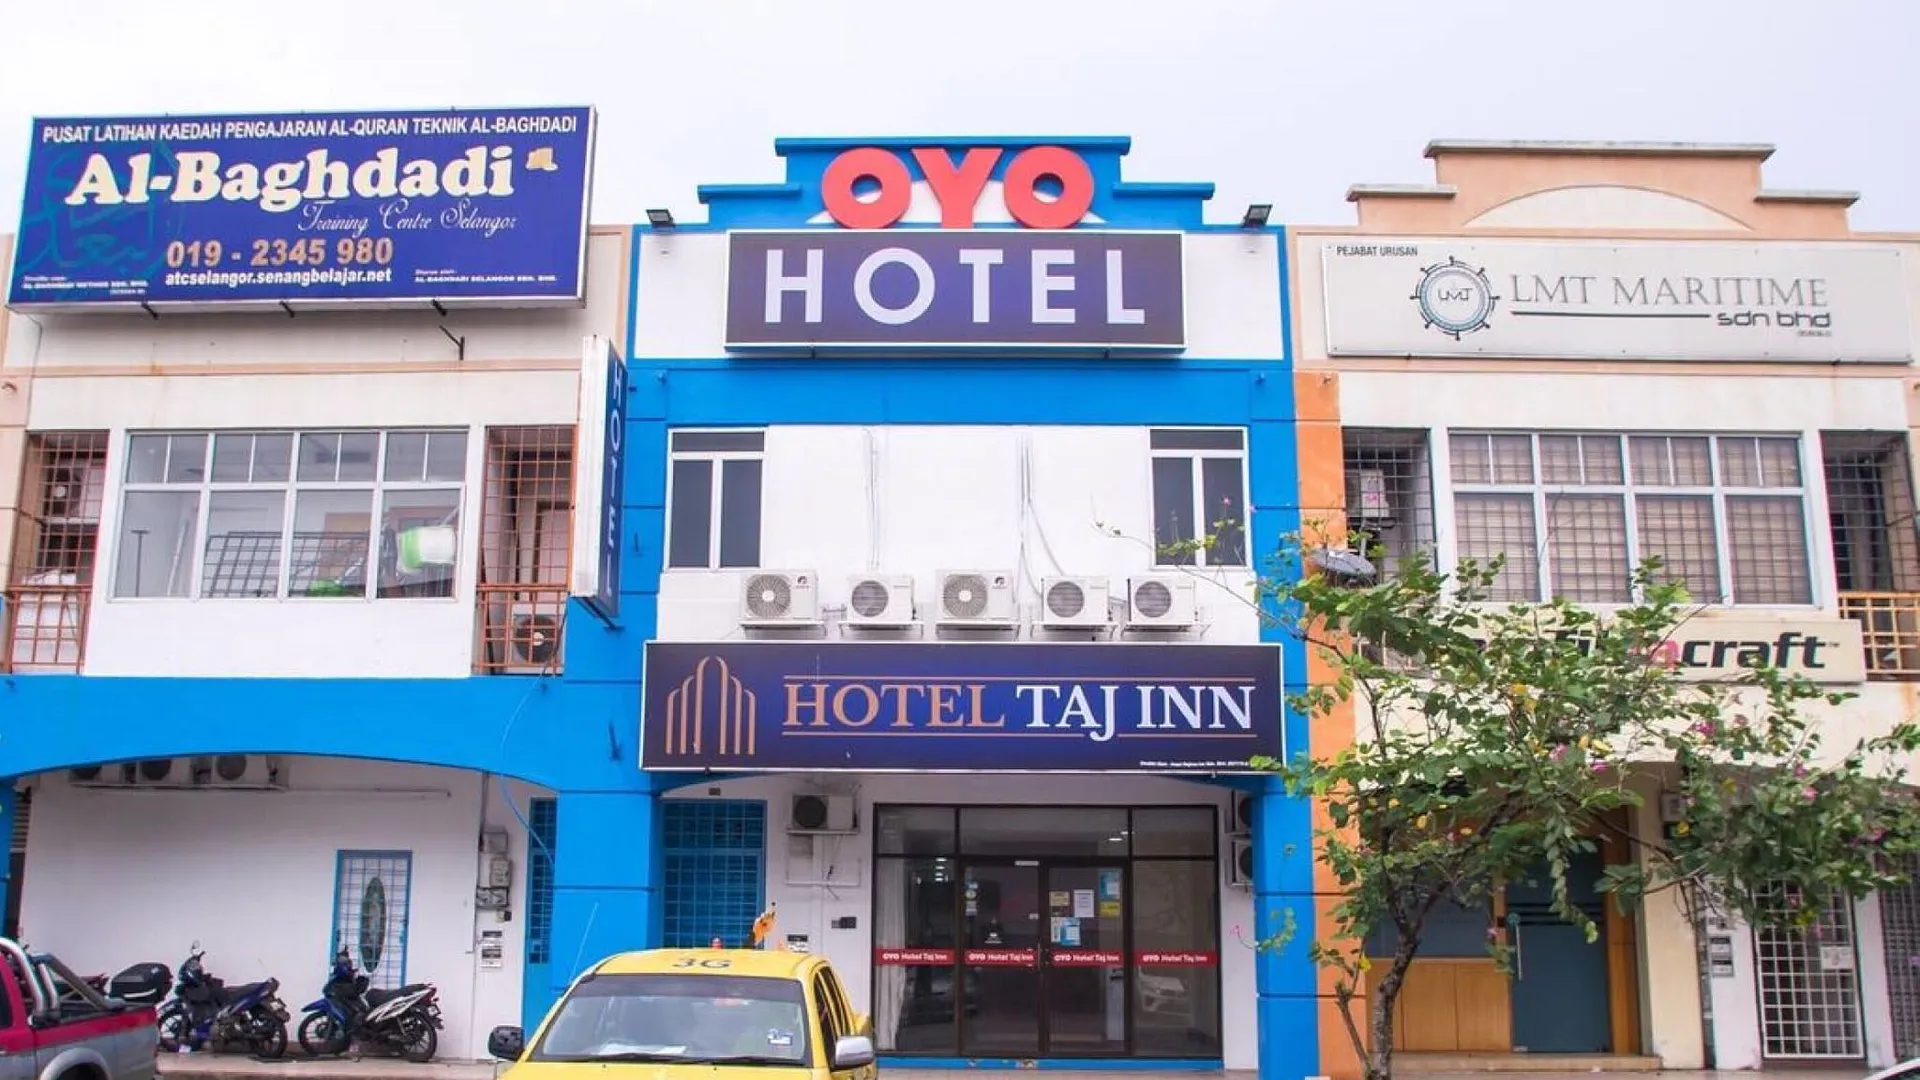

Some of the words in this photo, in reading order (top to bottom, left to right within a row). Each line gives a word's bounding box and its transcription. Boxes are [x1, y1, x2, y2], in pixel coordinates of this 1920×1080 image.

[43, 125, 91, 142] PUSAT
[94, 123, 156, 141] LATIHAN
[159, 121, 221, 140] KAEDAH
[225, 119, 326, 138] PENGAJARAN
[328, 118, 408, 137] AL-QURAN
[412, 117, 467, 134] TEKNIK
[470, 115, 577, 133] AL-BAGHDADI
[64, 145, 514, 212] Al-Baghdadi
[821, 145, 1094, 230] OYO
[297, 200, 369, 238] Training
[379, 198, 432, 231] Centre
[440, 198, 517, 238] Selangor
[165, 240, 222, 267] 019
[251, 238, 326, 266] 2345
[337, 237, 394, 265] 980
[1336, 245, 1377, 256] PEJABAT
[1379, 246, 1418, 257] URUSAN
[165, 268, 392, 287] atcselangor.senangbelajar.net
[765, 247, 1145, 324] HOTEL
[1510, 274, 1598, 304] LMT
[1613, 277, 1828, 308] MARITIME
[1717, 311, 1769, 326] sdn
[1777, 311, 1830, 327] bhd
[606, 359, 622, 597] HOTEL
[782, 683, 1005, 727] HOTEL
[1017, 685, 1120, 742] TAJ
[1137, 685, 1257, 729] INN
[672, 958, 732, 968] 3G
